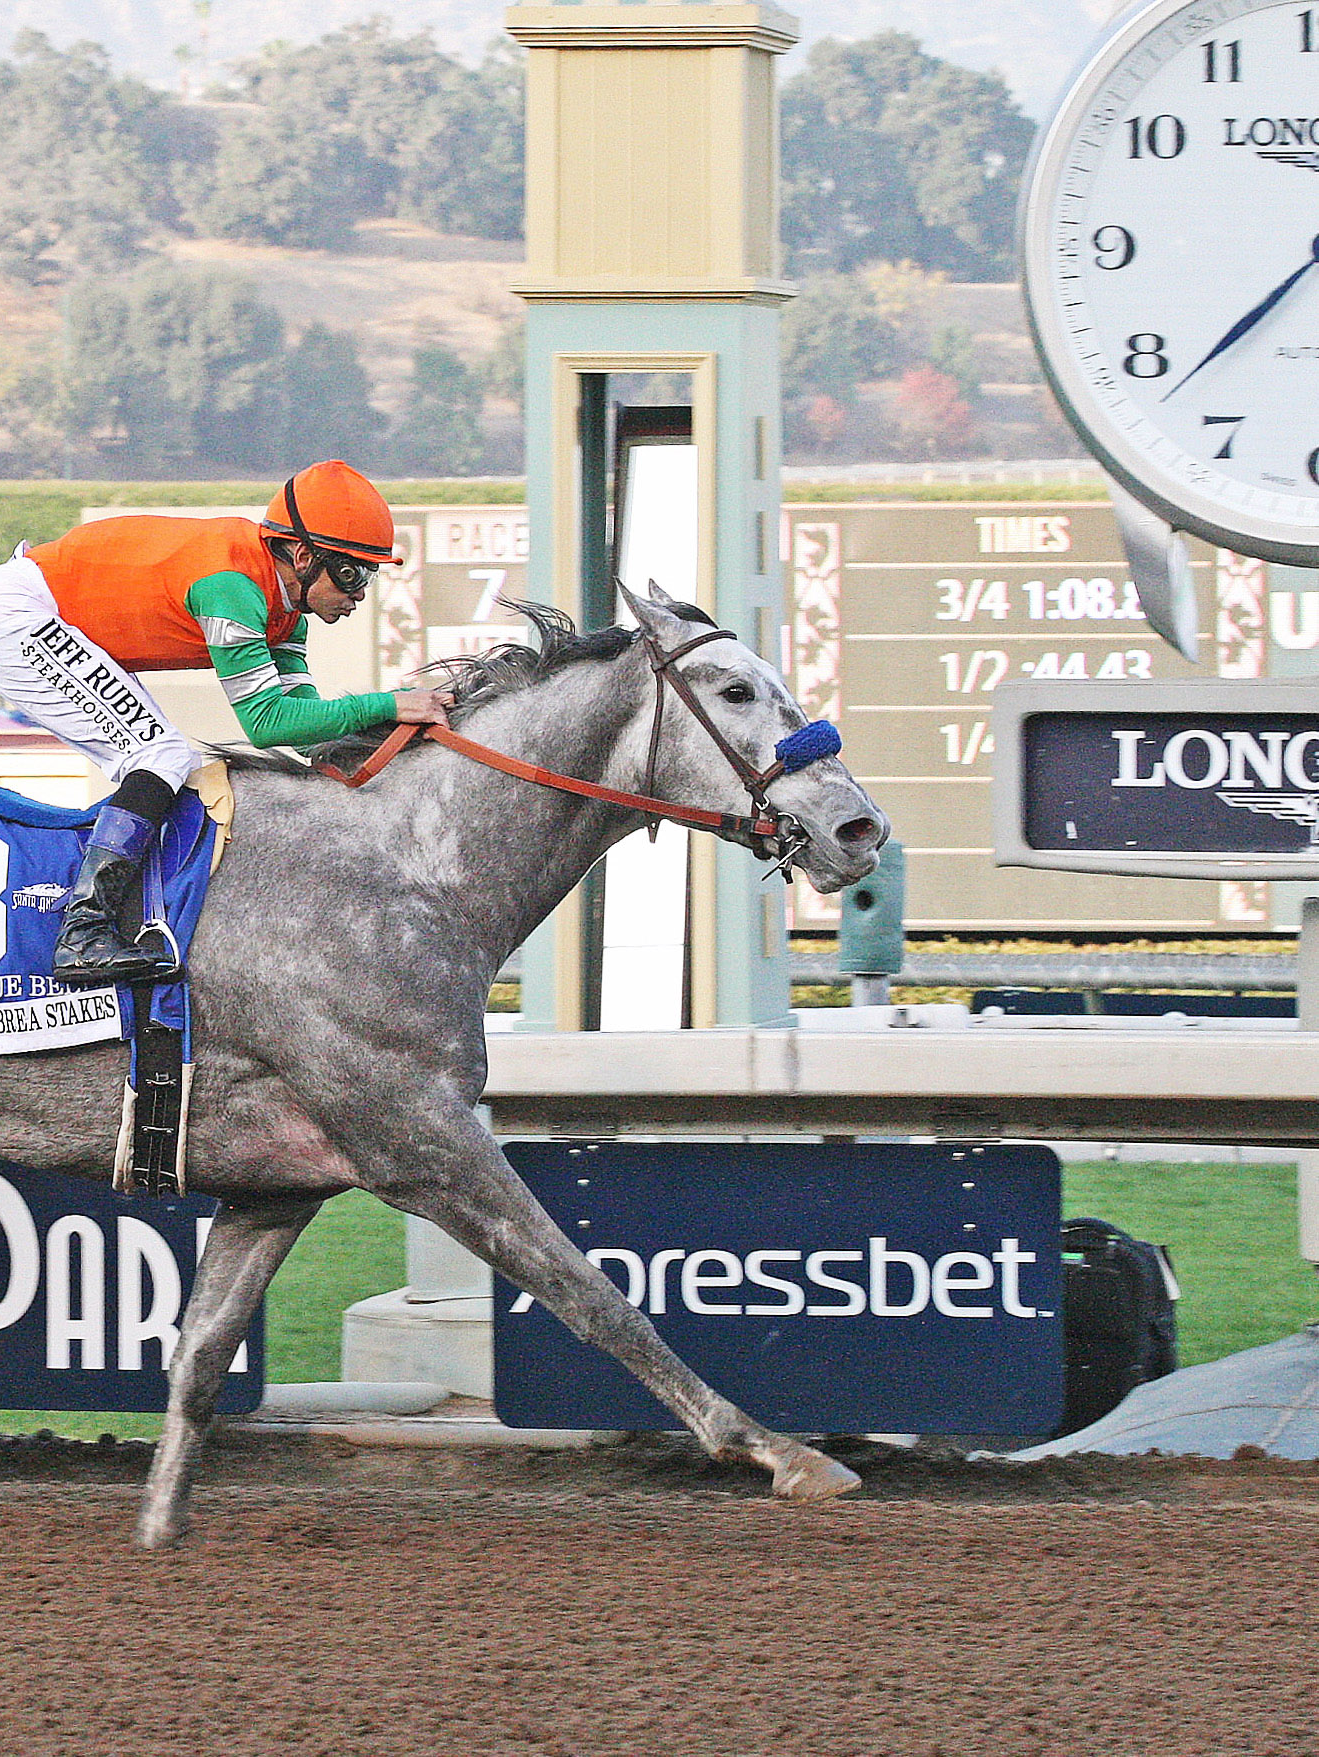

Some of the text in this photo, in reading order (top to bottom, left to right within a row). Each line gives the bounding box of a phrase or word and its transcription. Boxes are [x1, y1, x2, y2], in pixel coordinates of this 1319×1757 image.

[1200, 39, 1243, 83] 11
[1124, 114, 1186, 159] 10
[1093, 225, 1136, 270] 9
[1122, 332, 1169, 378] 8
[1201, 415, 1247, 459] 7
[974, 516, 1073, 553] TIMES
[468, 568, 508, 622] 7
[935, 578, 1011, 622] 3/4
[30, 617, 165, 742] JEFF RUBY'S
[939, 650, 1010, 694] 1/2
[45, 993, 117, 1029] STAKES
[509, 1237, 1037, 1317] pressbet
